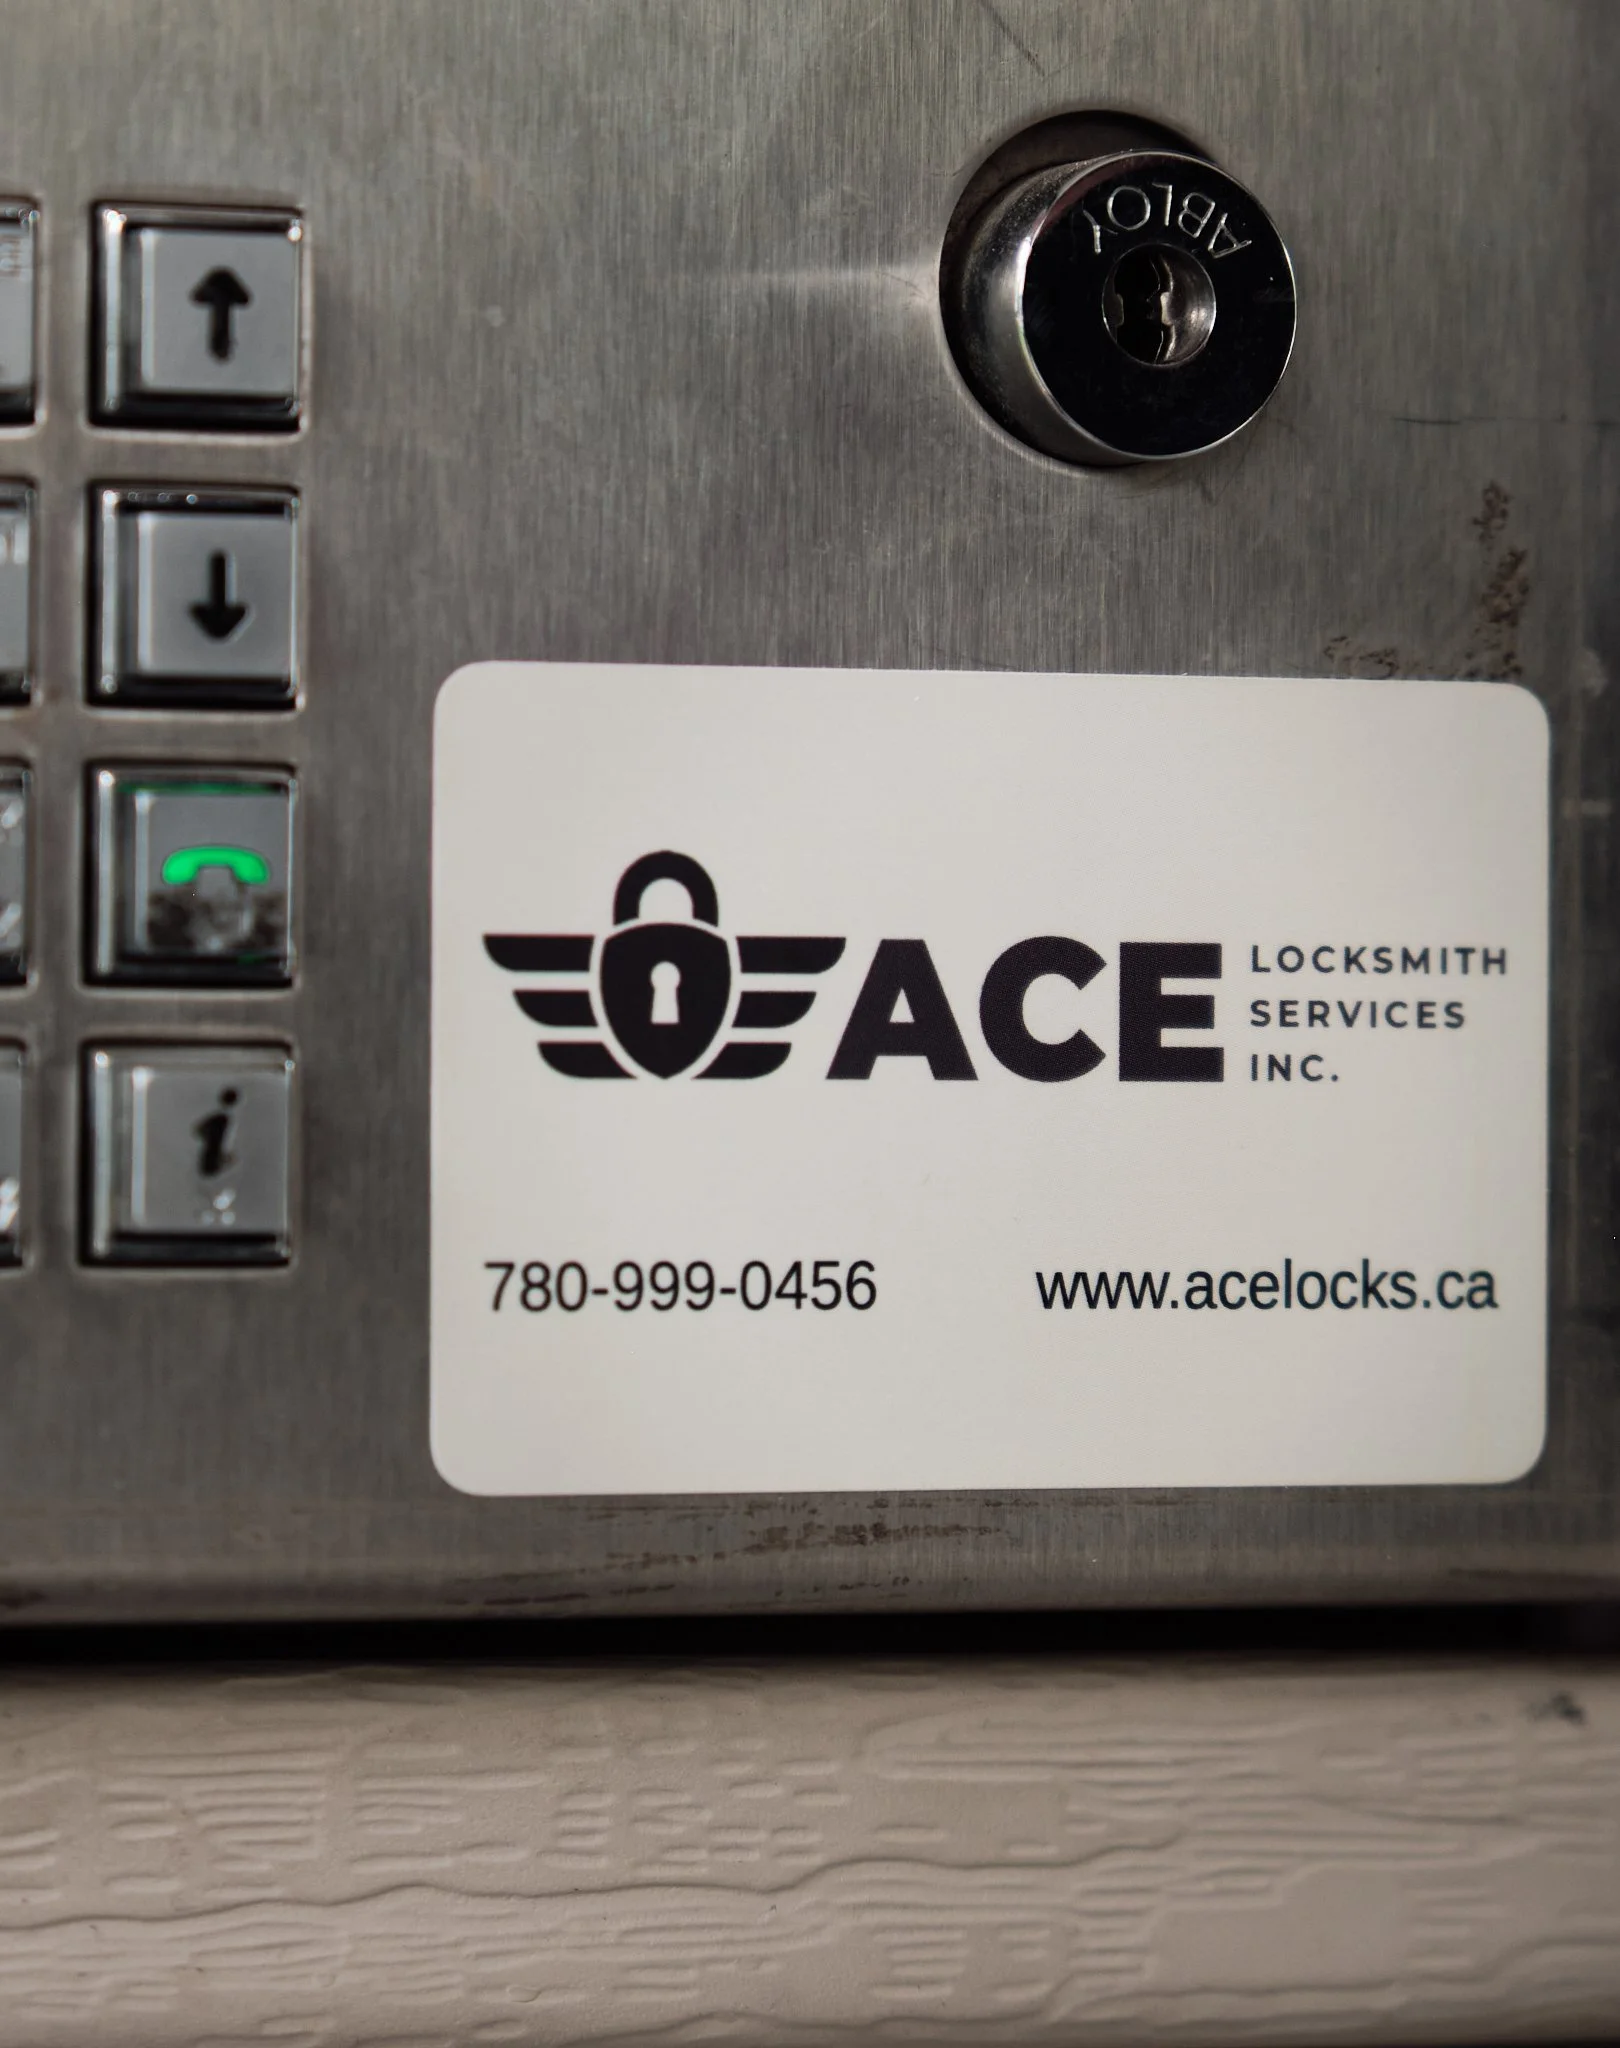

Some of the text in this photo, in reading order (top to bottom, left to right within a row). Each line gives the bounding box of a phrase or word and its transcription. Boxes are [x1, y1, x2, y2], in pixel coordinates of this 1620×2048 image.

[1081, 181, 1253, 259] ABLOY
[1251, 944, 1507, 975] LOCKSMITH
[826, 935, 1225, 1084] ACE
[1250, 999, 1466, 1030] SERVICES
[1250, 1053, 1340, 1083] INC.
[484, 1259, 878, 1313] 780-999-0456
[1035, 1257, 1501, 1311] www.acelocks.ca
